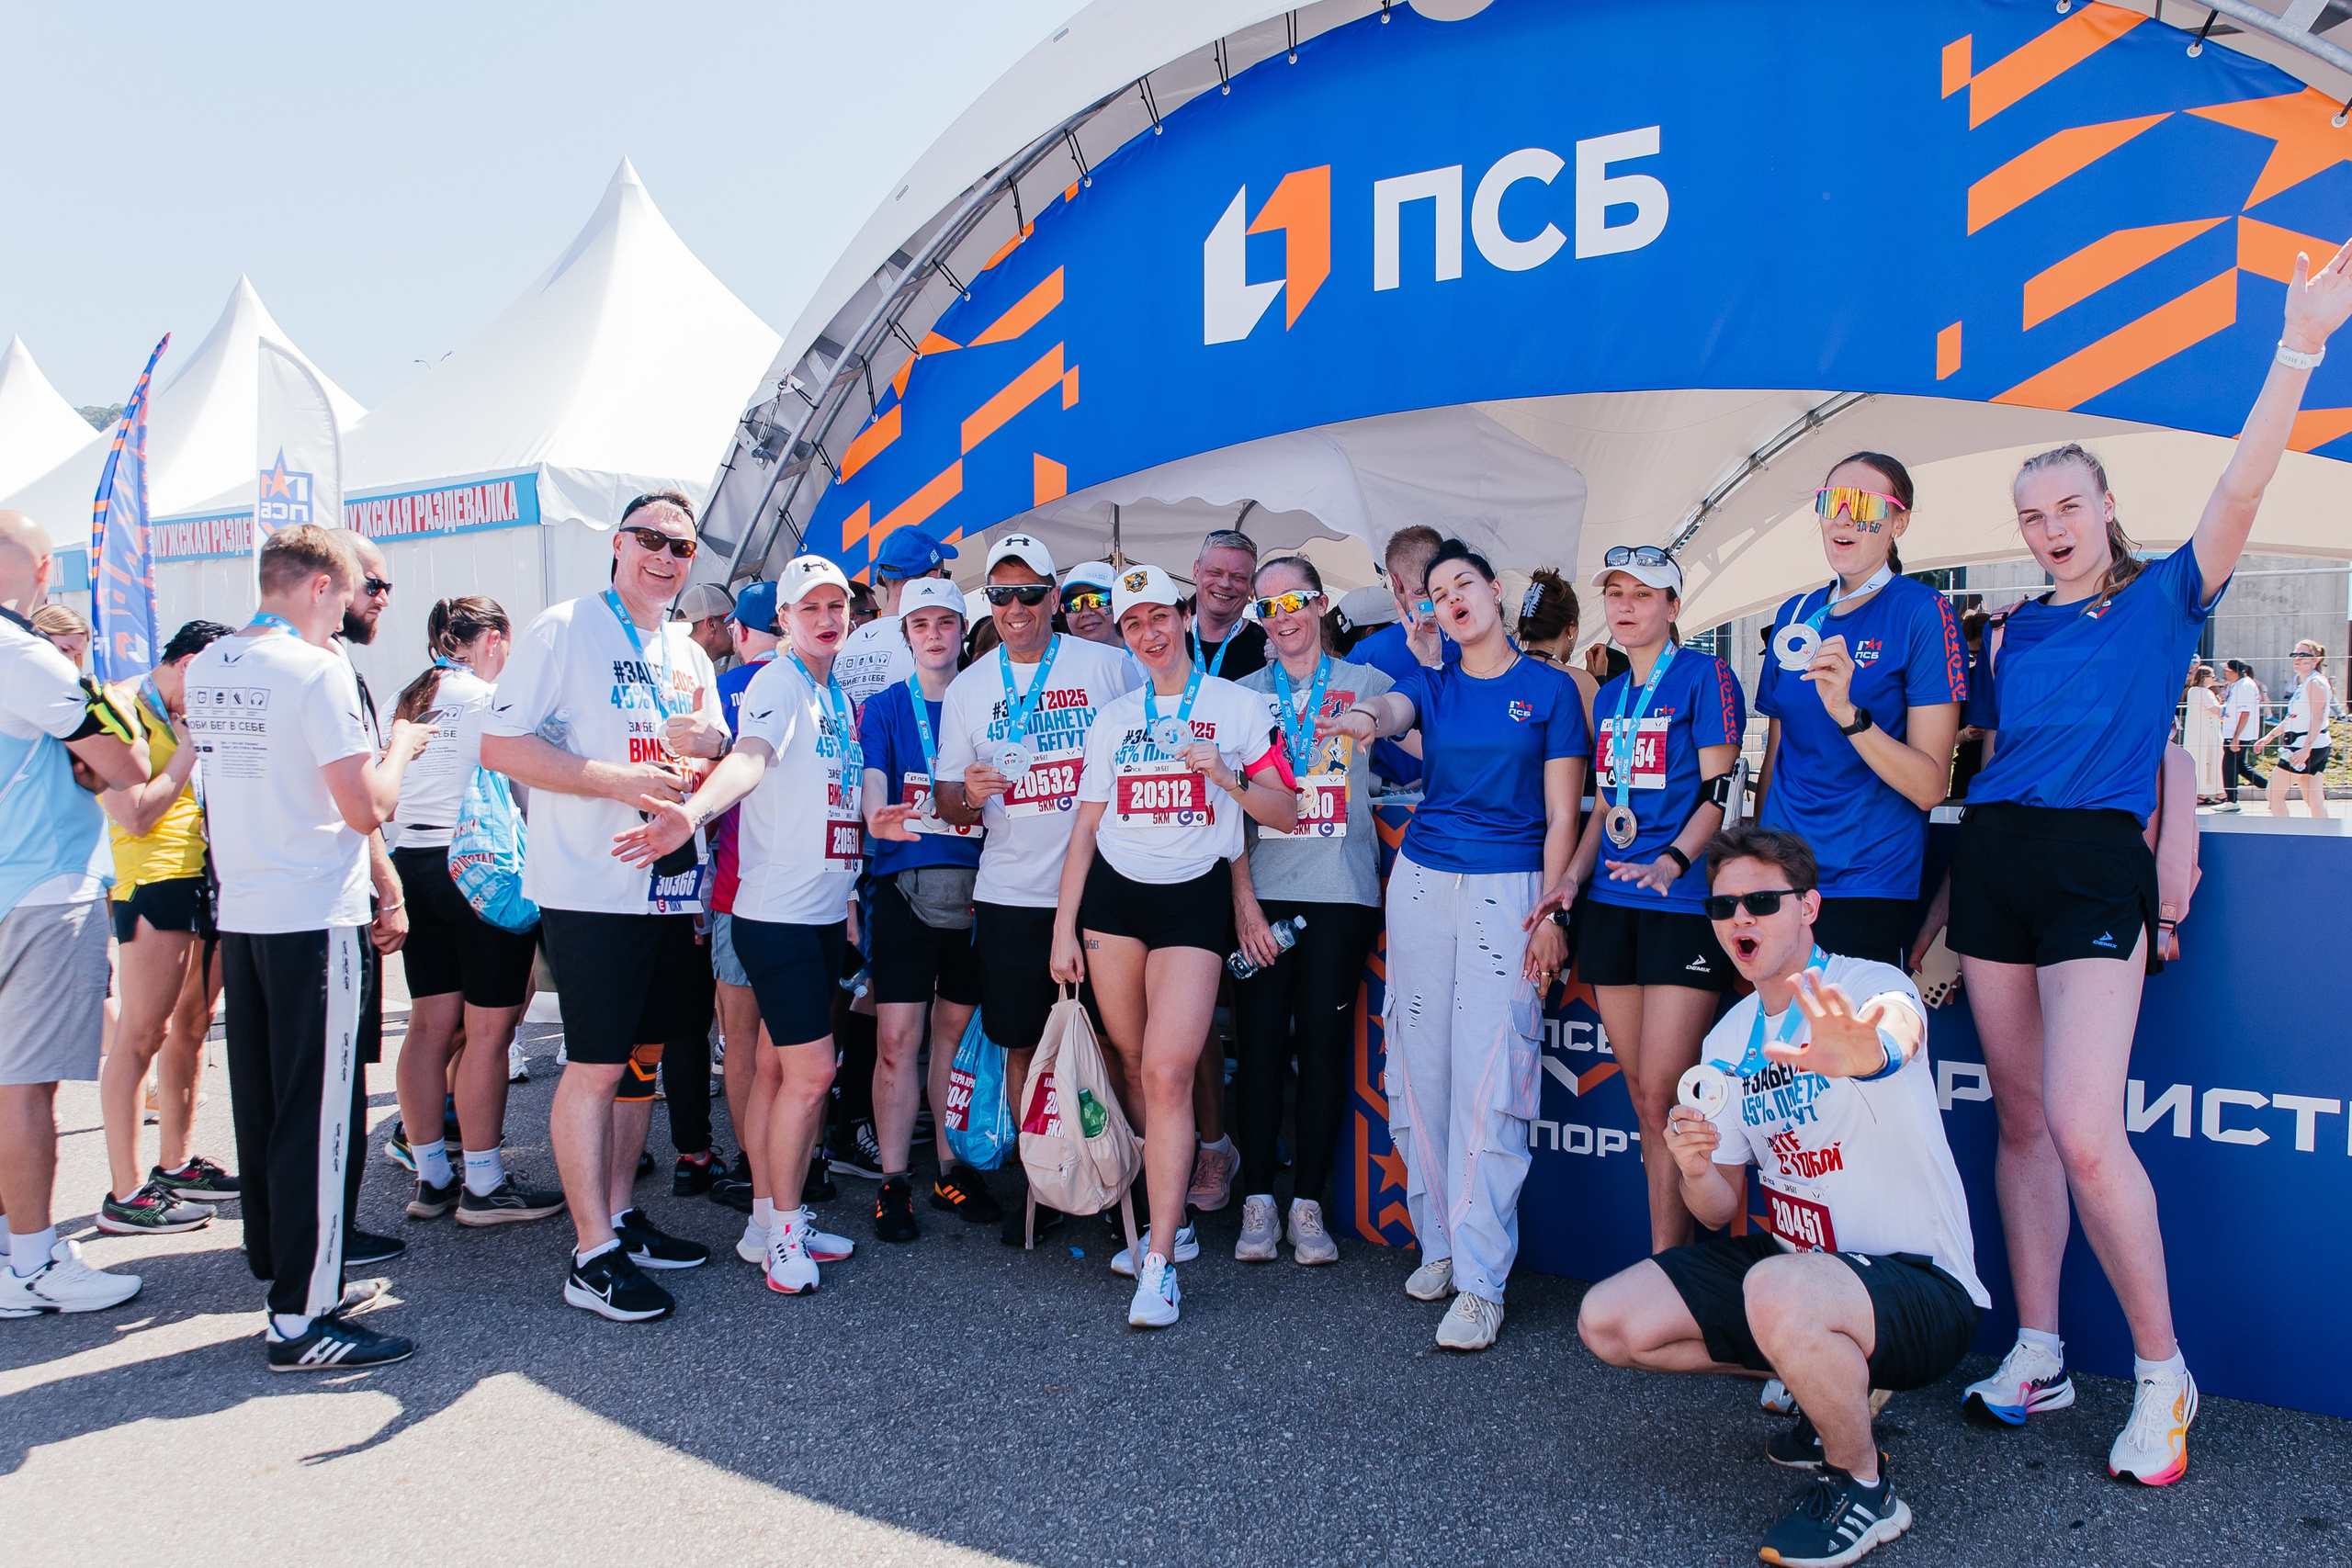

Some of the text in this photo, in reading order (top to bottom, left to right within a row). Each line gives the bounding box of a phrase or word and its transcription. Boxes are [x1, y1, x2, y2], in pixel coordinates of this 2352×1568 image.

[1374, 125, 1669, 292] ПСБ
[414, 480, 520, 534] РАЗДЕВАЛКА
[1046, 647, 1056, 660] ПСБ
[1855, 651, 1880, 660] ПСБ
[1187, 685, 1196, 698] ПСБ
[1509, 708, 1532, 716] ПСБ
[210, 721, 227, 730] БЕГ
[231, 721, 236, 730] В
[239, 721, 266, 733] СЕБЕ
[1012, 765, 1076, 799] 20532
[1131, 779, 1193, 809] 20312
[832, 827, 859, 854] 20531
[656, 870, 697, 897] 30366
[2093, 940, 2118, 949] DEMIX
[1685, 964, 1711, 973] DEMIX
[1771, 1197, 1826, 1247] 20451
